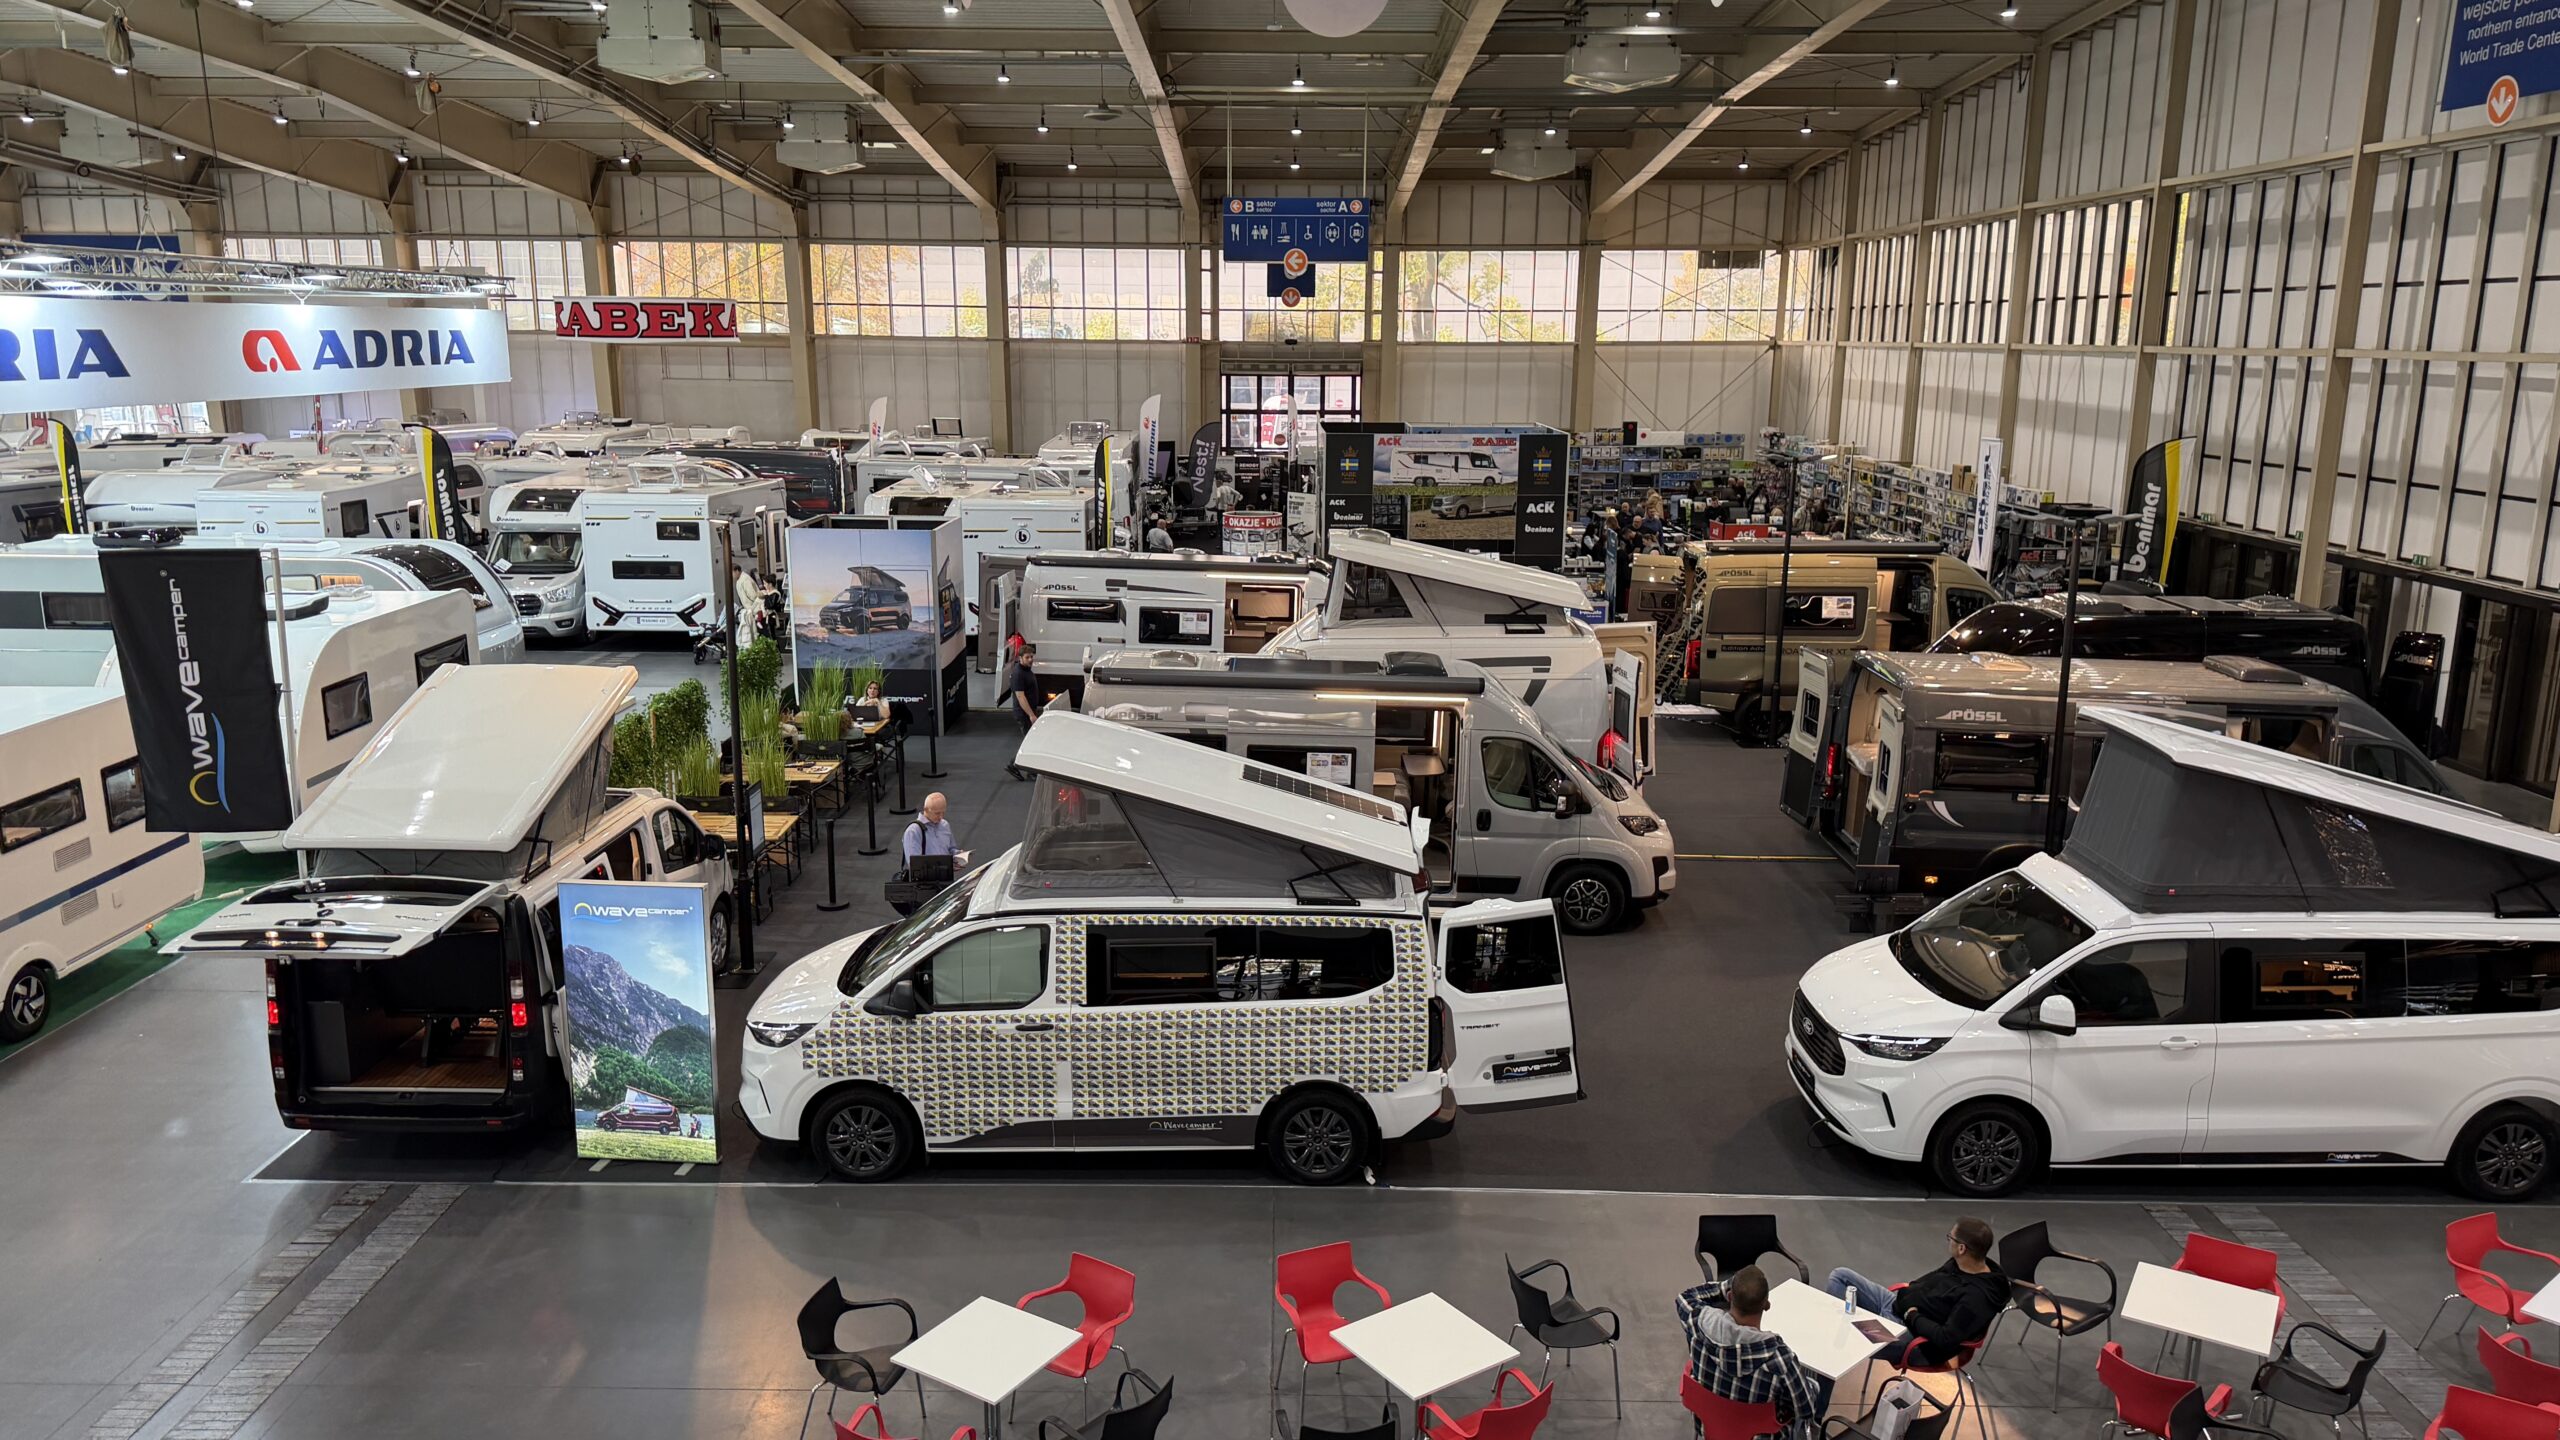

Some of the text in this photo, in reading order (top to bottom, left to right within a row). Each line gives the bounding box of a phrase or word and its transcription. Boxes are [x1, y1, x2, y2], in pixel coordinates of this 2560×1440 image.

[2467, 19, 2513, 41] northern
[2459, 45, 2490, 66] World
[2492, 38, 2525, 58] Trade
[1245, 201, 1254, 213] B
[1338, 201, 1348, 213] A
[313, 329, 475, 370] ADRIA
[1378, 437, 1517, 447] ACK KABE
[1190, 438, 1210, 493] Nest!
[1526, 503, 1555, 514] ACK
[1228, 517, 1260, 527] OKAZJE
[1333, 512, 1364, 521] benimar
[1525, 523, 1555, 533] benimar
[2122, 482, 2162, 574] benimar
[2302, 646, 2347, 656] PÖSSL
[169, 578, 213, 769] wavecamper
[1951, 708, 2007, 722] PÖSSL
[593, 906, 689, 917] wavecamper
[1460, 1023, 1500, 1031] TRANSIT
